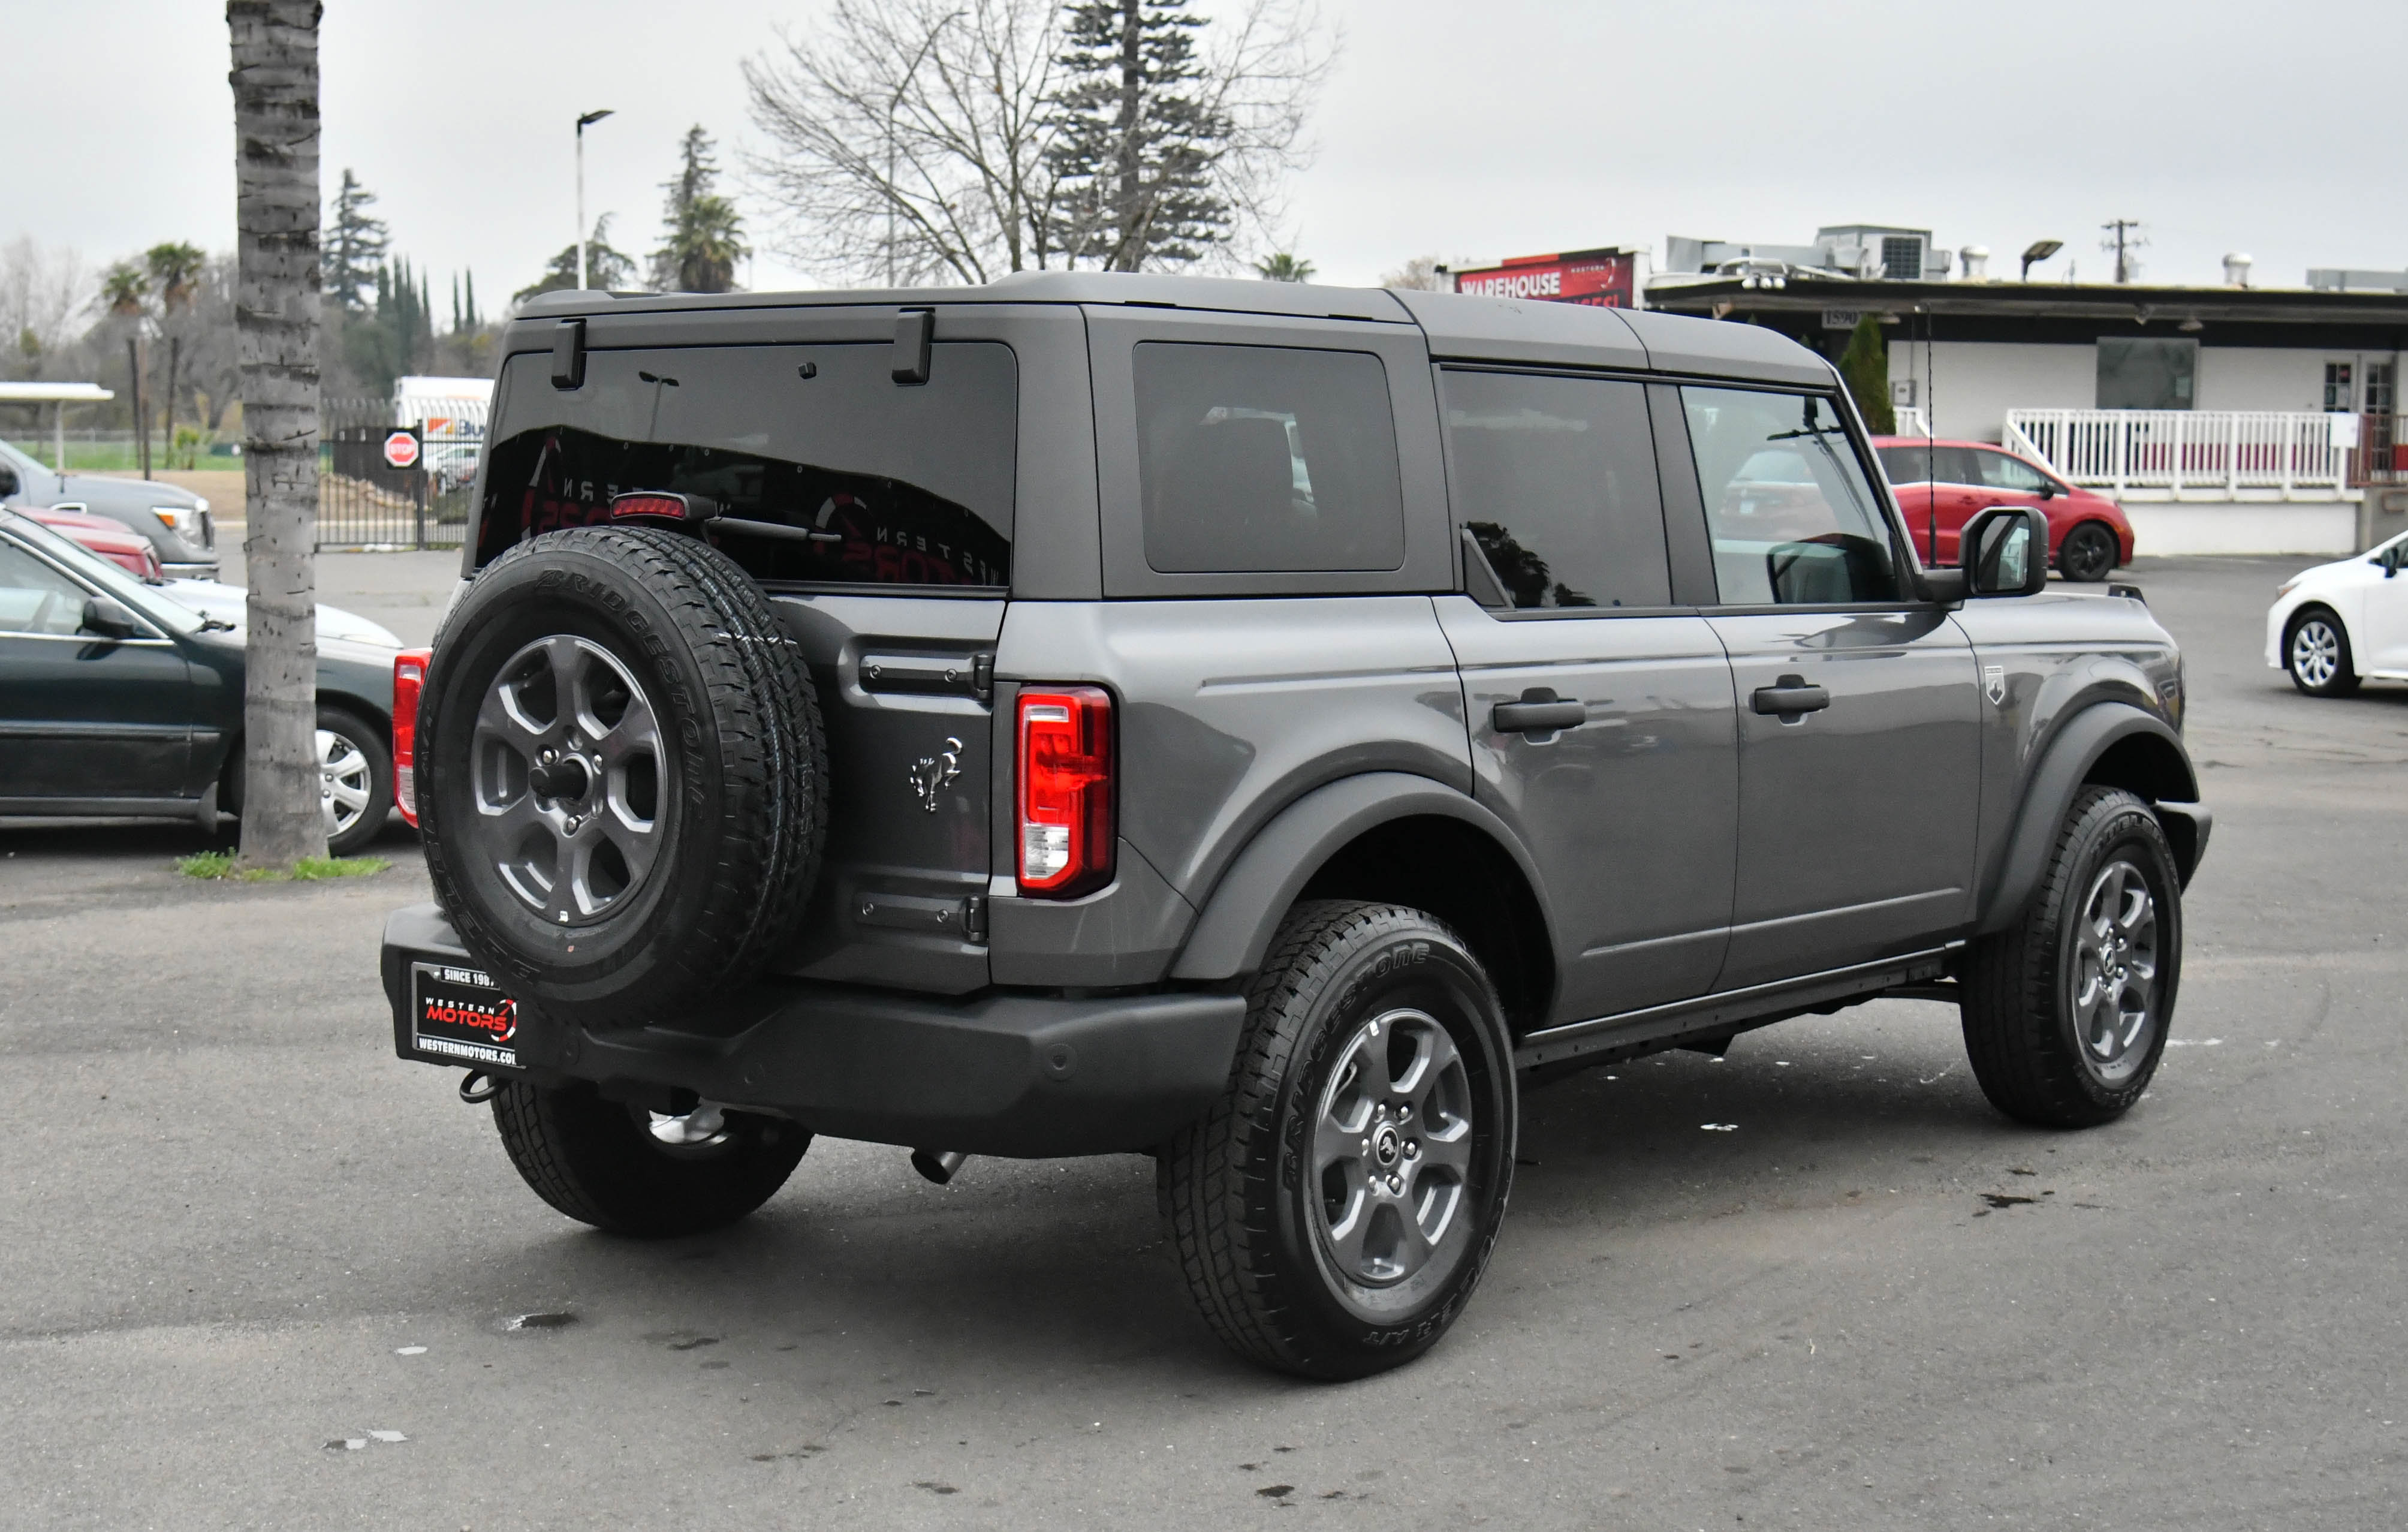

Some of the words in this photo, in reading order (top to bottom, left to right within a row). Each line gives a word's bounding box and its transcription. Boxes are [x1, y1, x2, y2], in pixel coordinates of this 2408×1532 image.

[1461, 272, 1561, 299] WAREHOUSE
[389, 444, 415, 455] STOP
[444, 968, 471, 983] SINCE
[425, 997, 495, 1015] WESTERN
[426, 1005, 508, 1032] MOTORS
